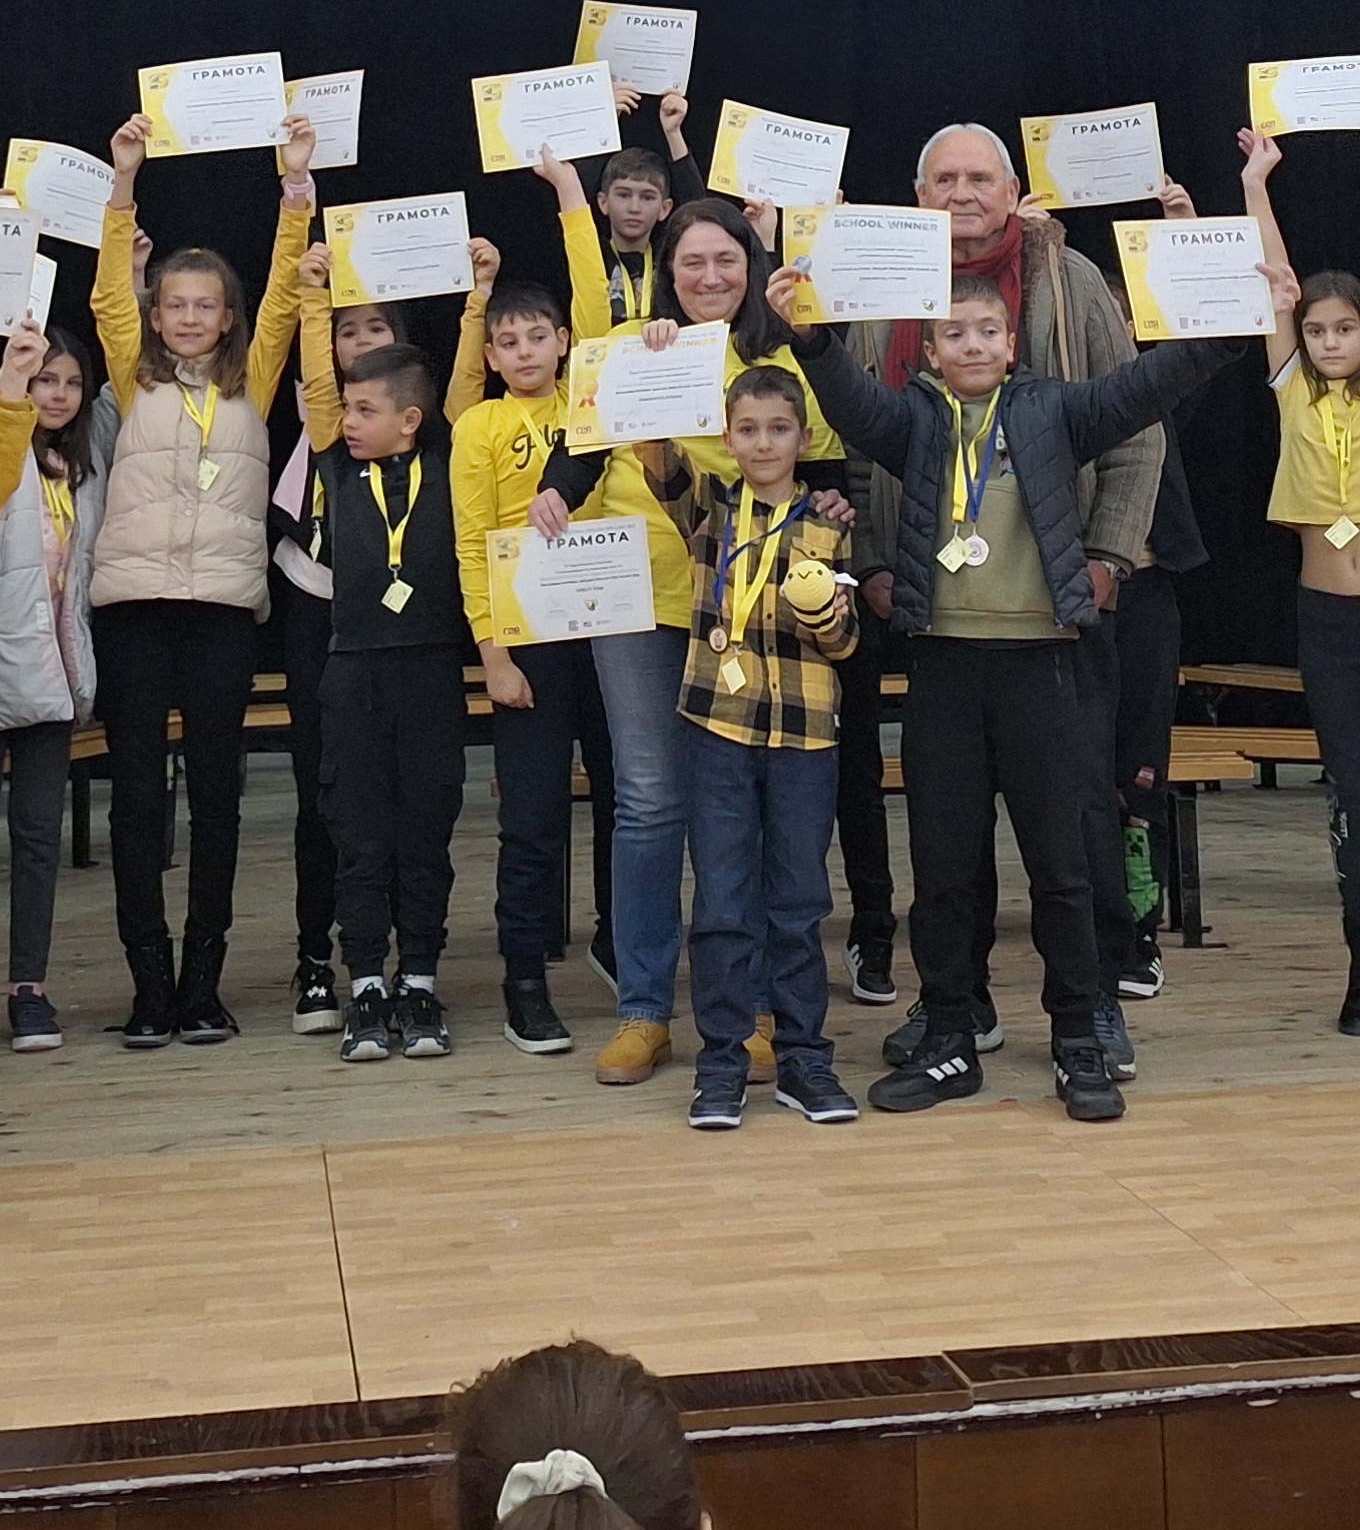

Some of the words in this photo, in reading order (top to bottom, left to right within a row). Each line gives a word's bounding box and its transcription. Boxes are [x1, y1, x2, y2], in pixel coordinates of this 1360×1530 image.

[626, 16, 684, 30] ГРАМОТА
[192, 65, 266, 81] ГРАМОТА
[305, 84, 351, 99] ГРАМОТА
[525, 74, 595, 93] ГРАМОТА
[765, 123, 832, 145] ГРАМОТА
[1072, 117, 1142, 135] ГРАМОТА
[377, 206, 451, 224] ГРАМОТА
[834, 219, 883, 229] SCHOOL
[888, 220, 939, 232] WINNER
[1171, 231, 1246, 247] ГРАМОТА
[547, 531, 630, 550] ГРАМОТА
